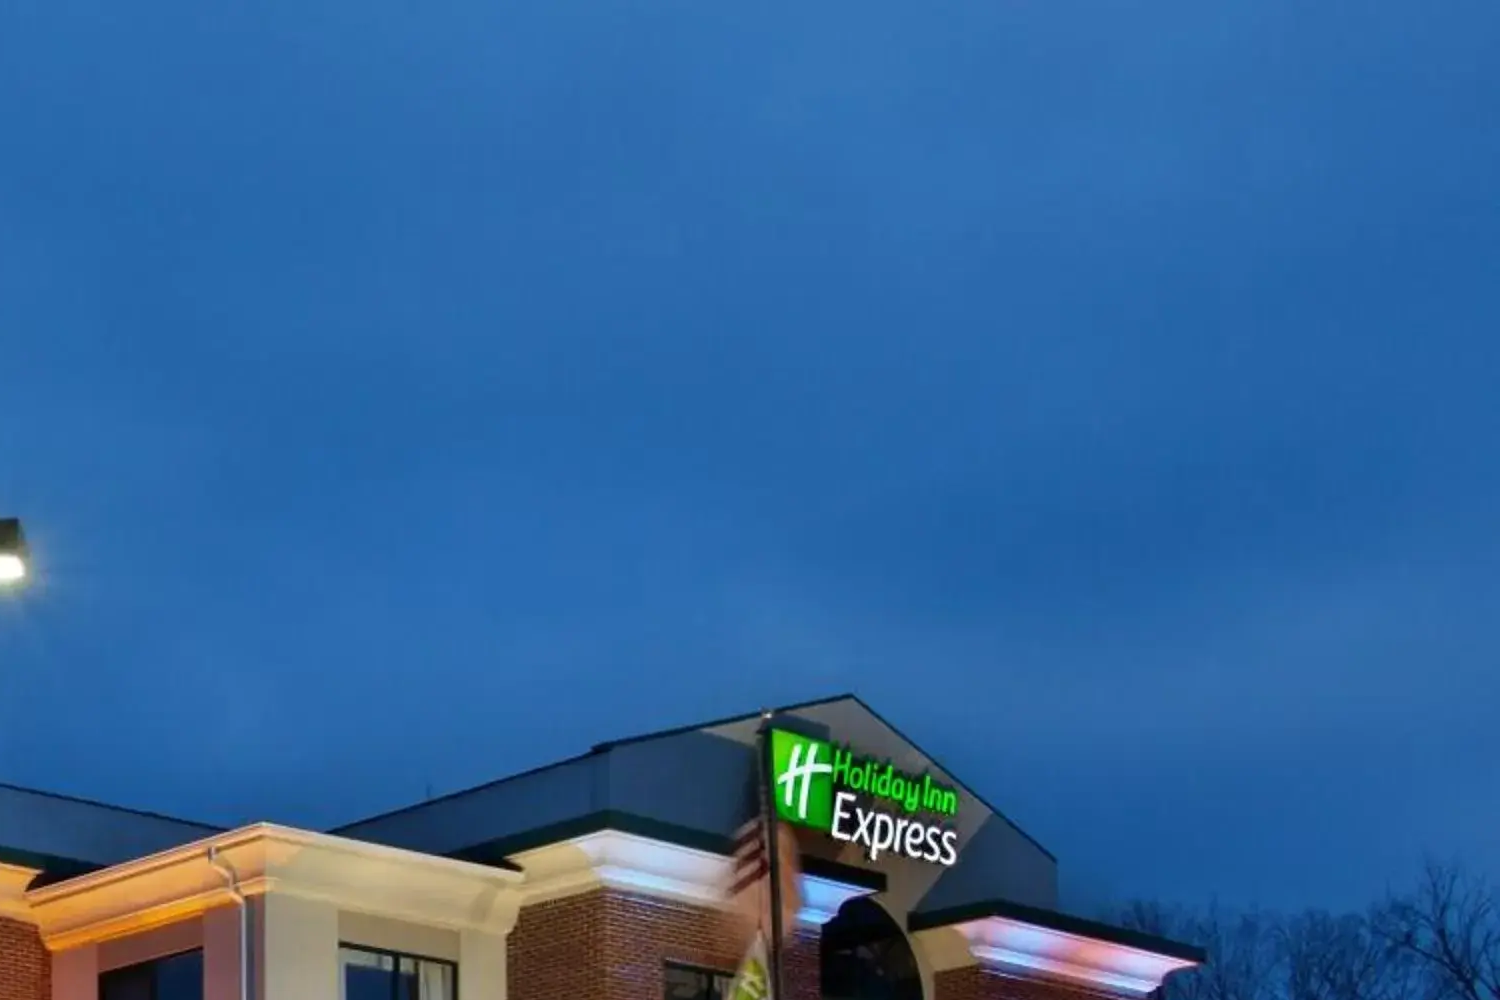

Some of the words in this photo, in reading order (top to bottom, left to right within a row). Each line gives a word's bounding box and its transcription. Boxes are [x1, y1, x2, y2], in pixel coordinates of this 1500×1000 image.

[833, 749, 920, 812] Holiday
[923, 775, 956, 815] Inn
[831, 791, 957, 866] Express
